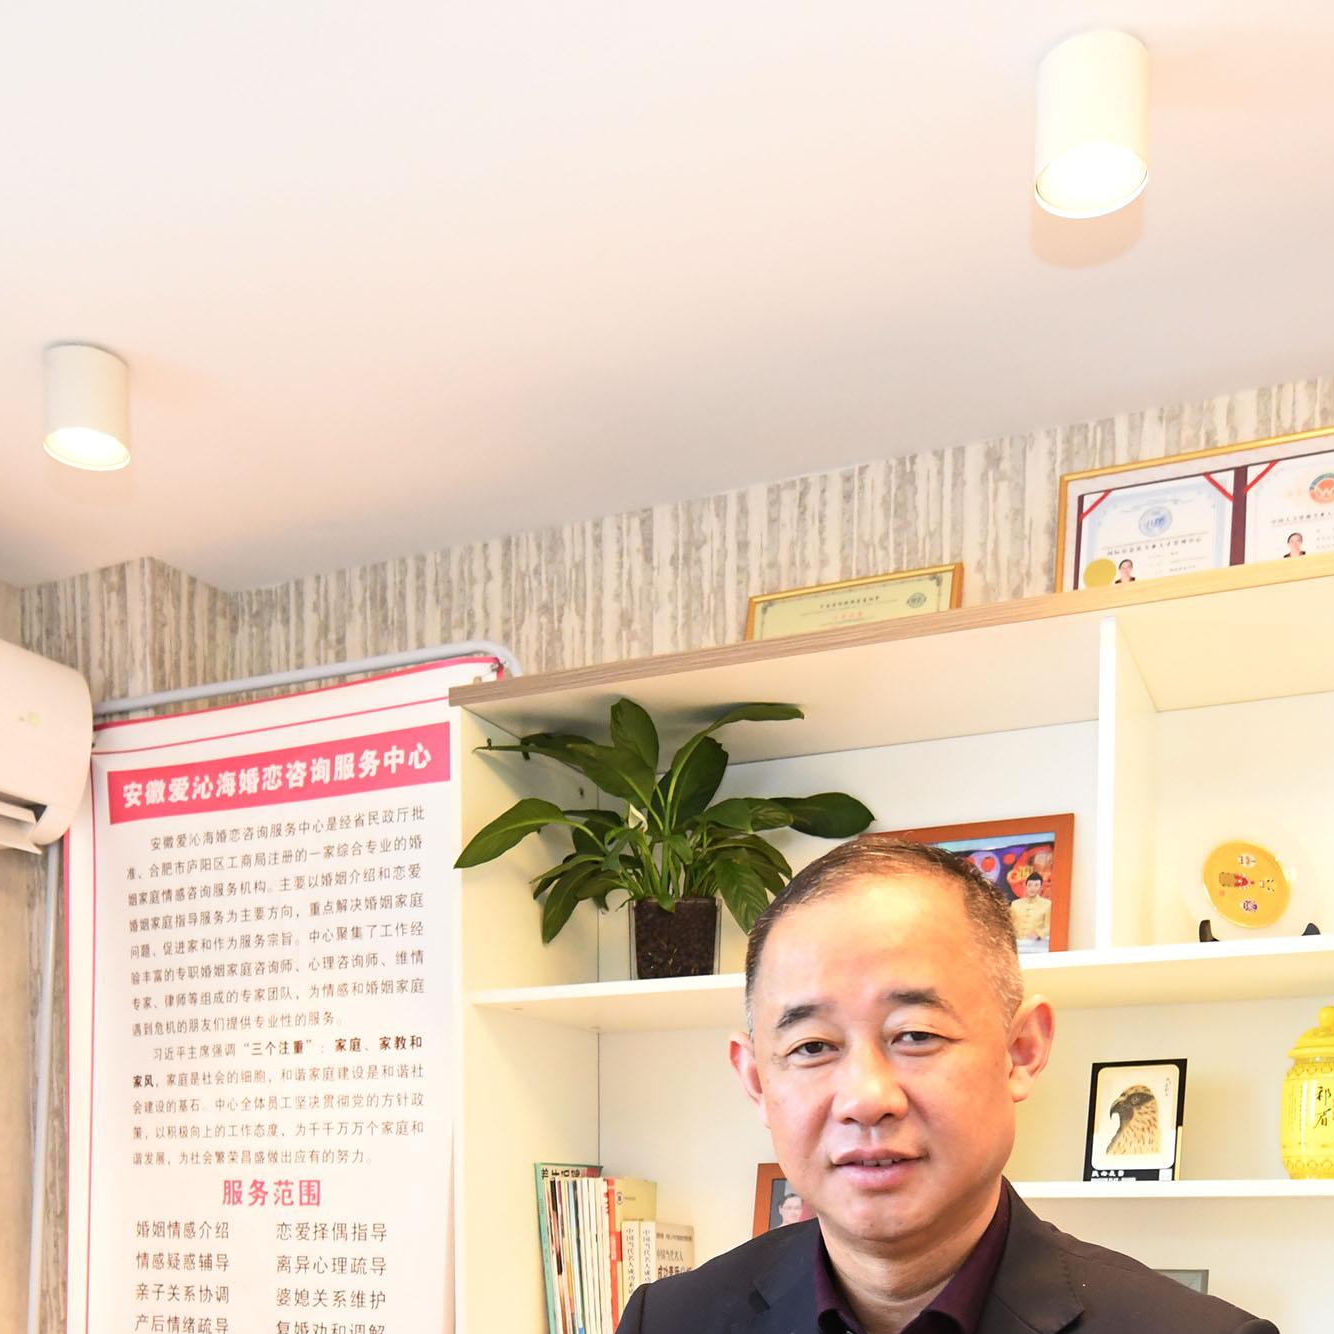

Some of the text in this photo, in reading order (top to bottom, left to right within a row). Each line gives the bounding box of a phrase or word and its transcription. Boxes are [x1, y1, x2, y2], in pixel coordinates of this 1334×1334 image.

[123, 743, 431, 808] 安徽爱沁海婚恋咨询服务中心
[150, 805, 425, 851] 安徽爱沁海婚恋咨询服务中心是经省民政厅批
[222, 1179, 321, 1206] 服务范围
[136, 1220, 229, 1240] 婚姻情感介绍
[276, 1221, 387, 1242] 恋爱择偶指导
[136, 1251, 229, 1272] 情感疑惑辅导
[276, 1254, 387, 1276] 离异心理疏导
[135, 1282, 229, 1304] 亲子关系协调
[276, 1288, 386, 1310] 婆媳关系维护
